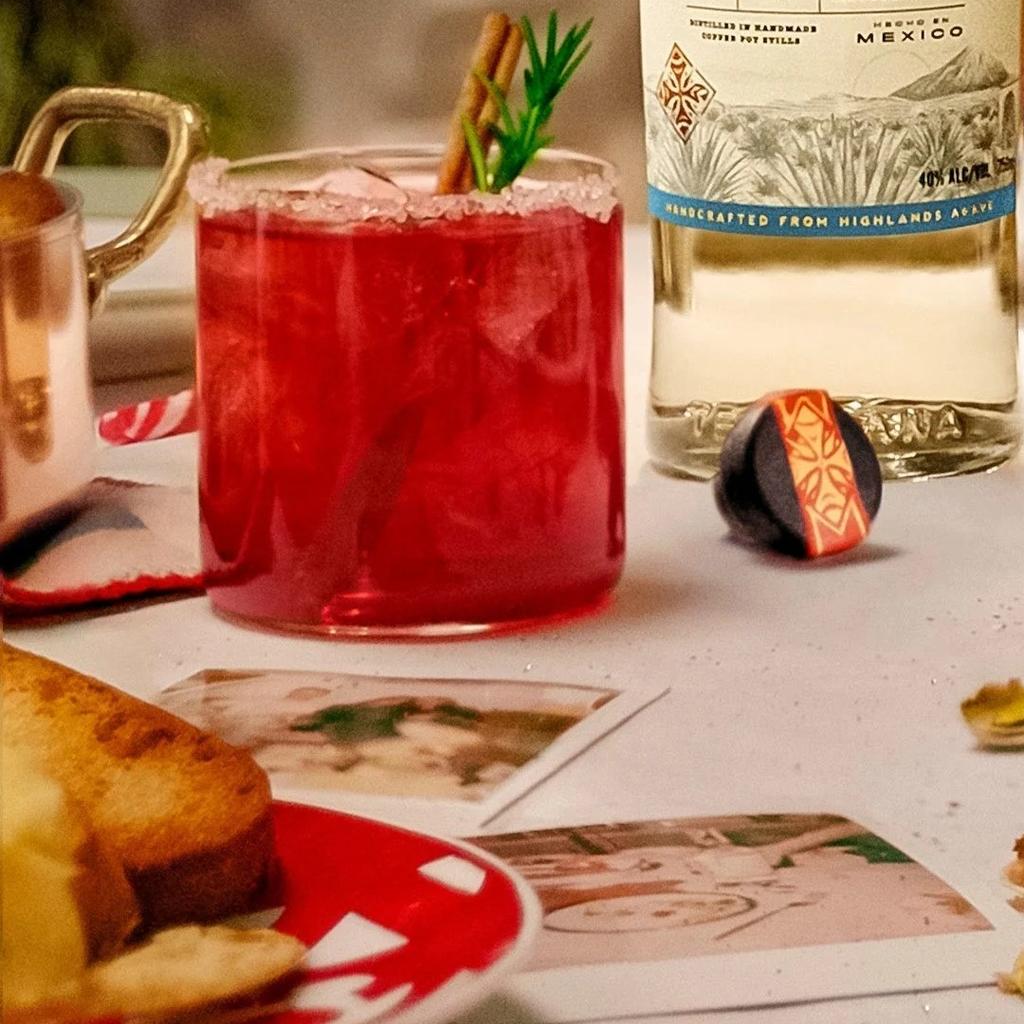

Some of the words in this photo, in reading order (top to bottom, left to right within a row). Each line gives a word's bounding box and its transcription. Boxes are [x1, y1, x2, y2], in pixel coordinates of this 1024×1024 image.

[690, 18, 736, 30] DISTILLED
[739, 23, 751, 31] IN
[754, 24, 817, 33] HANDMADE
[740, 35, 759, 43] POT
[763, 36, 800, 45] STILLS
[857, 26, 963, 43] MEXICO
[919, 168, 945, 189] 40%
[665, 203, 769, 226] HANDCRAFTED
[779, 215, 828, 227] FROM
[839, 209, 942, 227] HIGHLANDS
[951, 200, 993, 219] AGAVE
